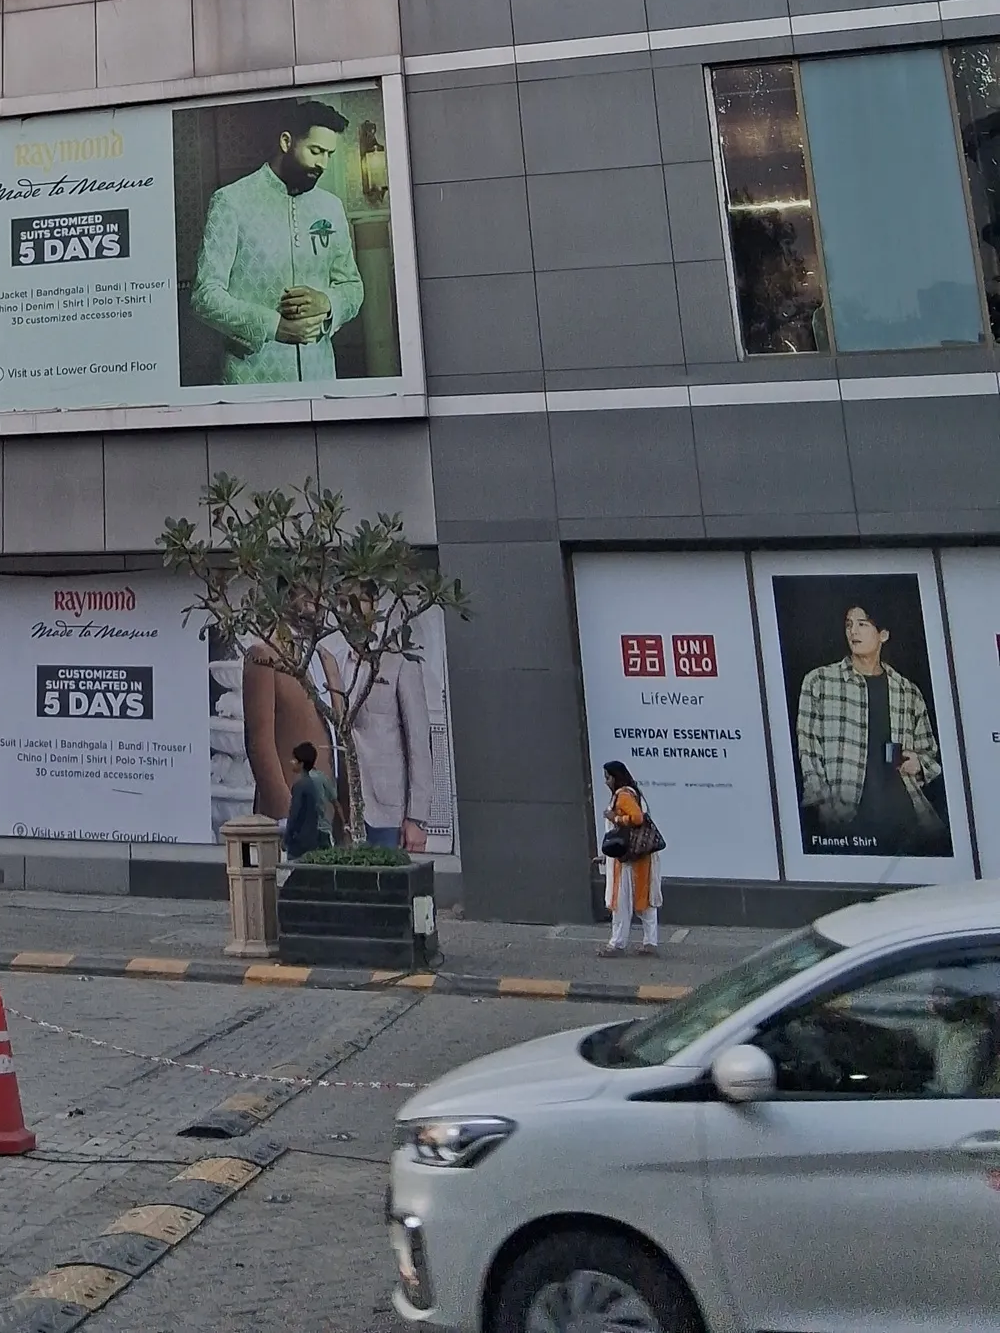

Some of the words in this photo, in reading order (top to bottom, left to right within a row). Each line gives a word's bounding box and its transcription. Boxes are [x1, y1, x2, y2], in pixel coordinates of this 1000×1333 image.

[14, 129, 125, 173] Raymond
[48, 174, 72, 197] to
[69, 176, 154, 196] Measure
[32, 214, 103, 229] CUSTOMIZED
[20, 229, 51, 241] SUITS
[53, 224, 104, 238] CRAFTED
[106, 223, 119, 233] IN
[19, 242, 35, 265] 5
[44, 234, 121, 263] DAYS
[0, 289, 28, 300] Jacket
[36, 285, 85, 300] Bandhgala
[95, 281, 122, 293] Bundi
[130, 280, 165, 291] Trouser
[26, 301, 55, 312] Denim
[62, 298, 85, 309] Shirt
[93, 296, 113, 306] Polo
[116, 293, 147, 305] T-Shirt
[11, 315, 24, 326] 3D
[26, 312, 78, 325] customized
[80, 309, 133, 321] accessories
[8, 367, 28, 379] Visit
[30, 369, 42, 378] us
[43, 367, 54, 377] at
[56, 365, 87, 376] Lower
[89, 362, 129, 374] Ground
[131, 361, 157, 372] Floor
[54, 586, 137, 617] Raymond
[31, 620, 73, 639] Made
[78, 620, 96, 638] to
[94, 624, 159, 640] Measure
[677, 639, 708, 656] UNI
[678, 657, 712, 673] QLO
[58, 669, 127, 680] CUSTOMIZED
[45, 680, 76, 690] SUITS
[78, 680, 128, 691] CRAFTED
[130, 682, 142, 691] IN
[43, 691, 60, 715] 5
[69, 692, 144, 717] DAYS
[641, 692, 704, 706] LifeWear
[613, 727, 669, 740] EVERYDAY
[673, 728, 742, 741] ESSENTIALS
[0, 738, 16, 748] Suit
[24, 739, 52, 749] Jacket
[60, 739, 108, 752] Bandhgala
[118, 741, 144, 751] Bundi
[153, 743, 187, 753] Trouser
[631, 746, 659, 758] NEAR
[662, 747, 718, 759] ENTRANCE
[722, 748, 728, 759] 1
[17, 753, 42, 763] Chino
[50, 754, 79, 764] Denim
[86, 755, 108, 765] Shirt
[115, 755, 136, 765] Polo
[139, 756, 168, 767] T-Shirt
[35, 767, 48, 777] 3D
[50, 768, 101, 779] customized
[103, 770, 155, 781] accessories
[31, 826, 51, 838] Visit
[53, 830, 65, 839] us
[68, 829, 76, 839] at
[79, 829, 109, 840] Lower
[112, 830, 149, 842] Ground
[812, 835, 849, 847] Flannel
[853, 836, 878, 847] Shirt
